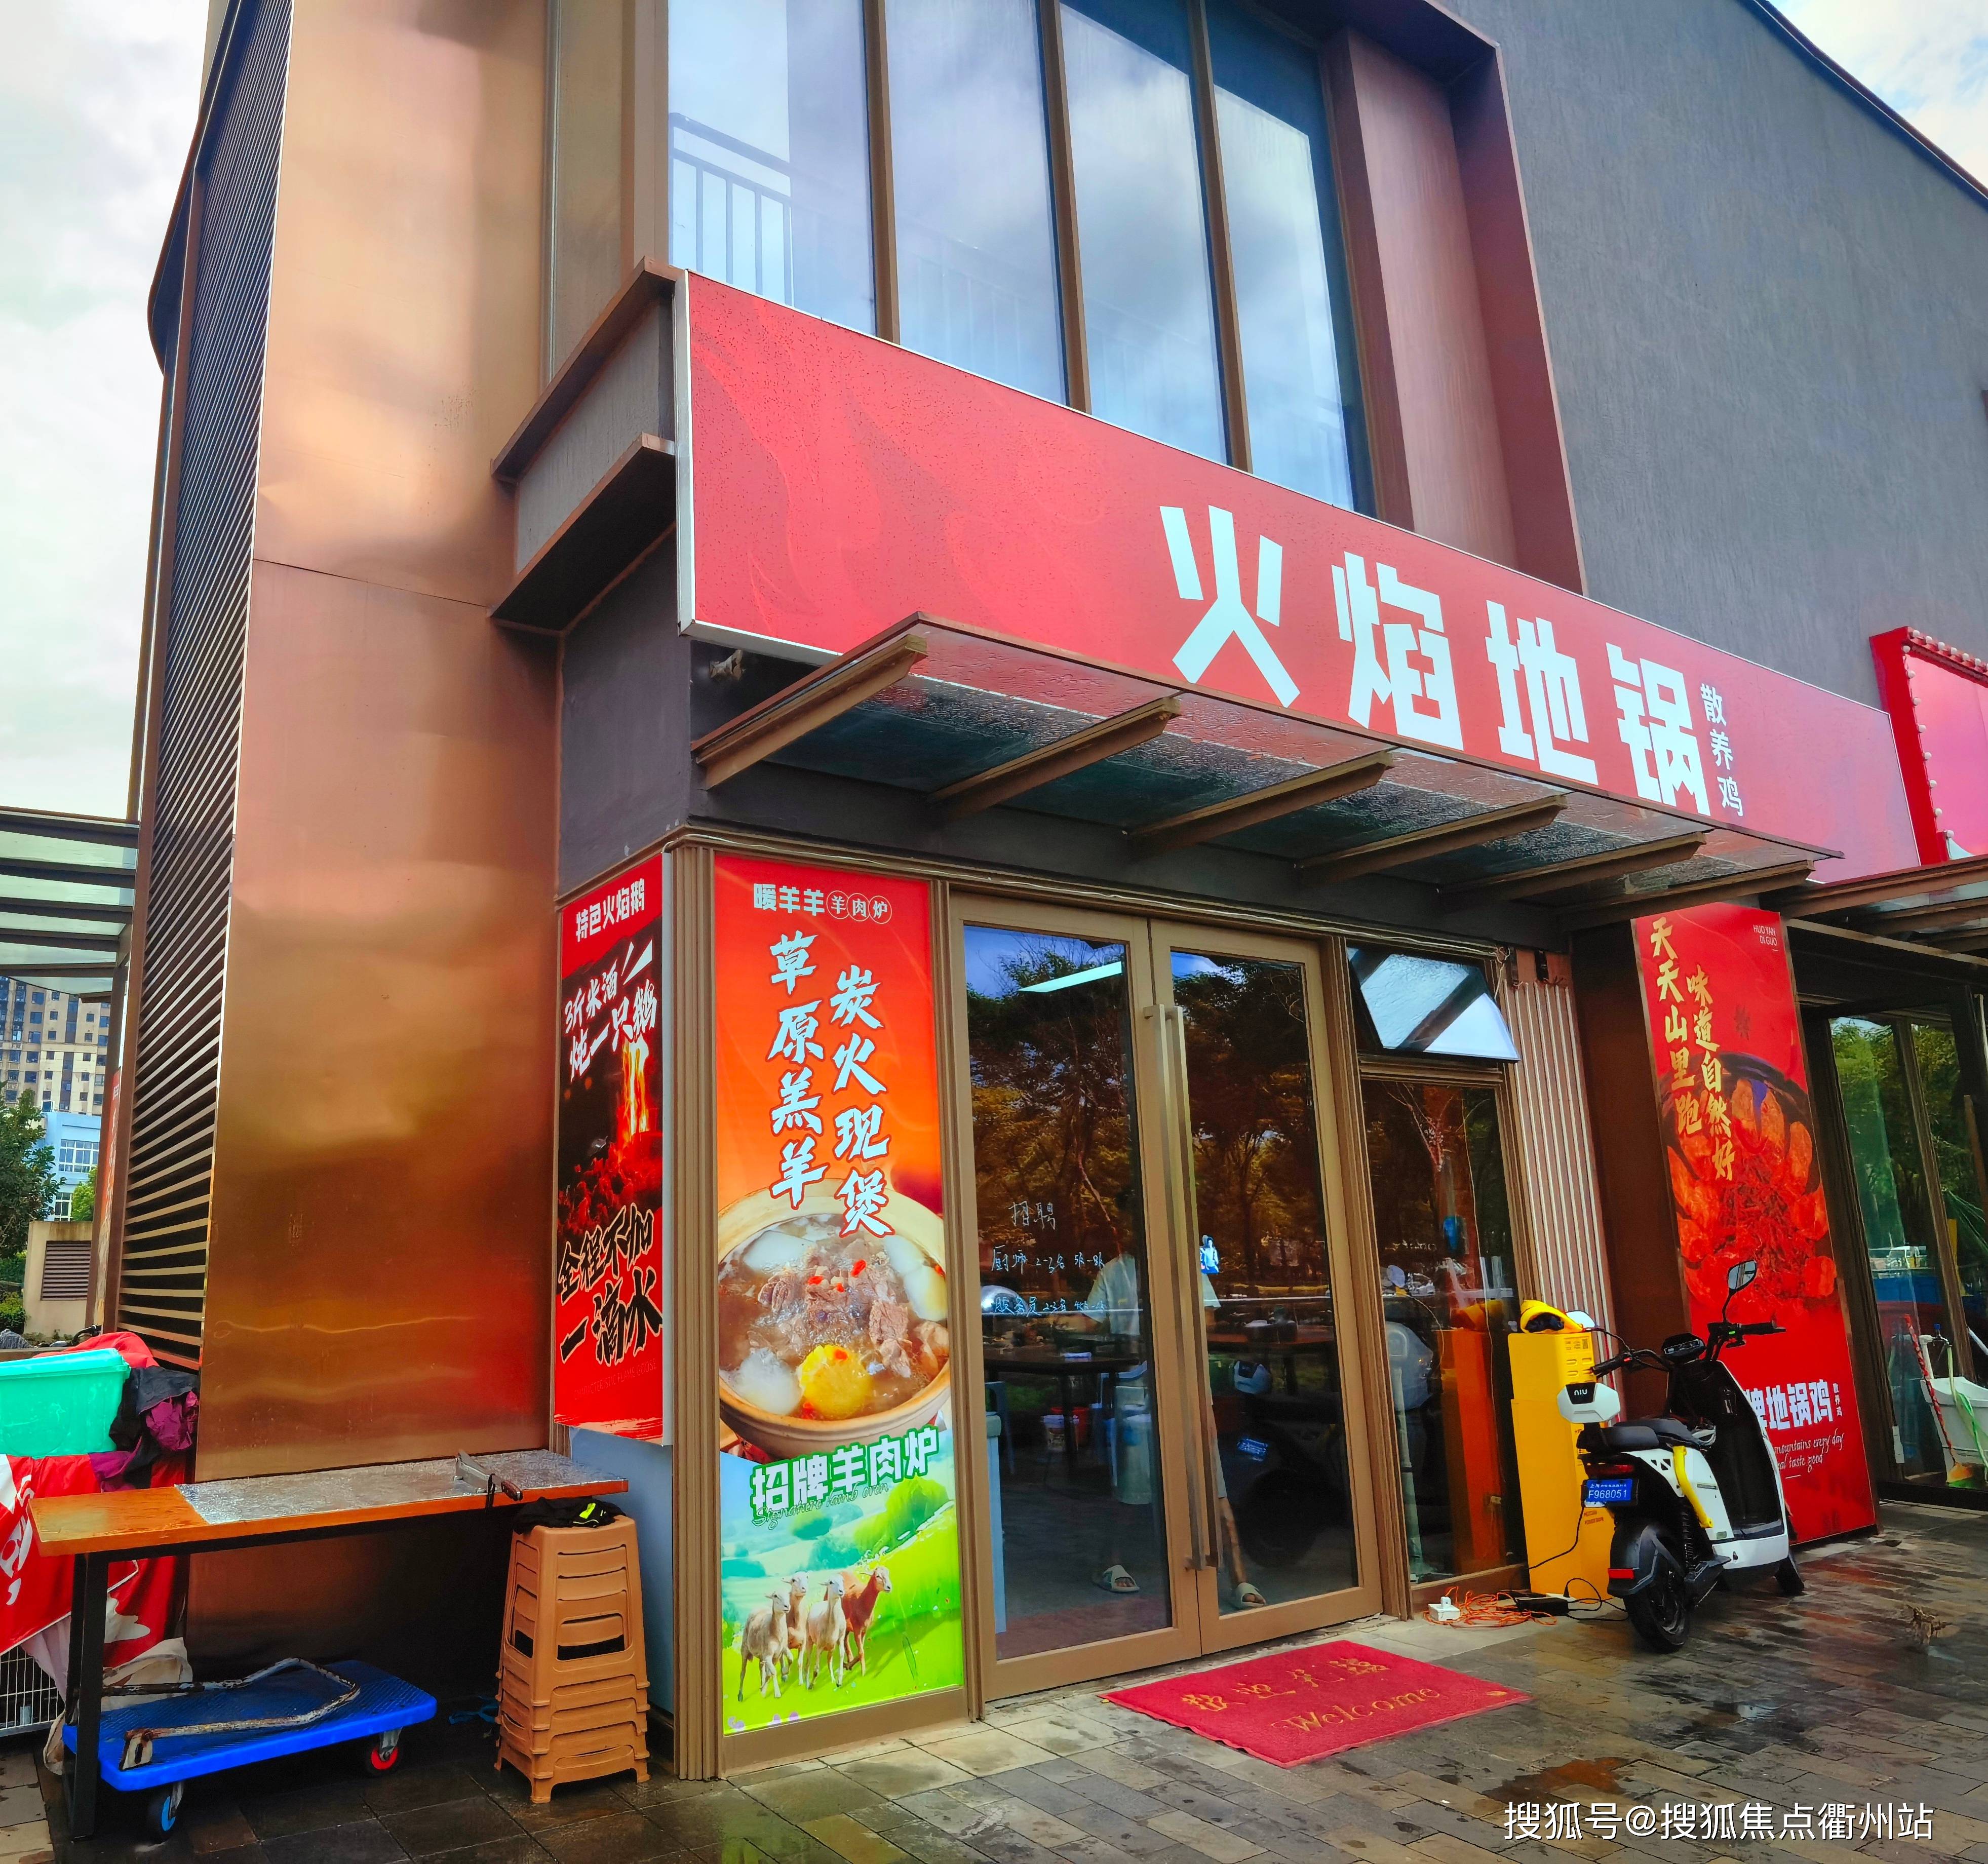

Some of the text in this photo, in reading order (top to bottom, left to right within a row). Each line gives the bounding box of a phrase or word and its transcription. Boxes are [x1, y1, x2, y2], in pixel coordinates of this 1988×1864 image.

[1159, 504, 1711, 817] 火焰地锅
[1700, 683, 1743, 817] 散养鸡
[575, 878, 645, 943] 特色火焰鹅
[753, 883, 825, 916] 暖羊羊
[831, 895, 888, 919] 羊肉炉
[1753, 924, 1776, 937] HUO YAN
[1760, 935, 1777, 946] DI GUO
[565, 959, 618, 1034] 3斤米酒
[1650, 916, 1702, 1135] 天天山里跑
[569, 979, 657, 1082] 炖一只鹅
[766, 929, 829, 1210] 草原羔羊
[830, 965, 895, 1238] 炭火现煲
[1686, 964, 1734, 1181] 味道自然好
[1008, 1200, 1056, 1230] 招聘
[558, 1203, 654, 1306] 全程不加
[560, 1266, 662, 1367] 一滴水
[617, 1367, 636, 1383] FLAME
[636, 1358, 657, 1376] GOOSE
[751, 1426, 938, 1514] 招牌羊肉炉
[1774, 1440, 1811, 1454] mountains
[1831, 1428, 1845, 1451] day
[1807, 1447, 1824, 1473] good
[752, 1481, 889, 1530] Signature lamb oven
[1588, 1490, 1627, 1499] F968051
[1271, 1686, 1442, 1733] Welcome
